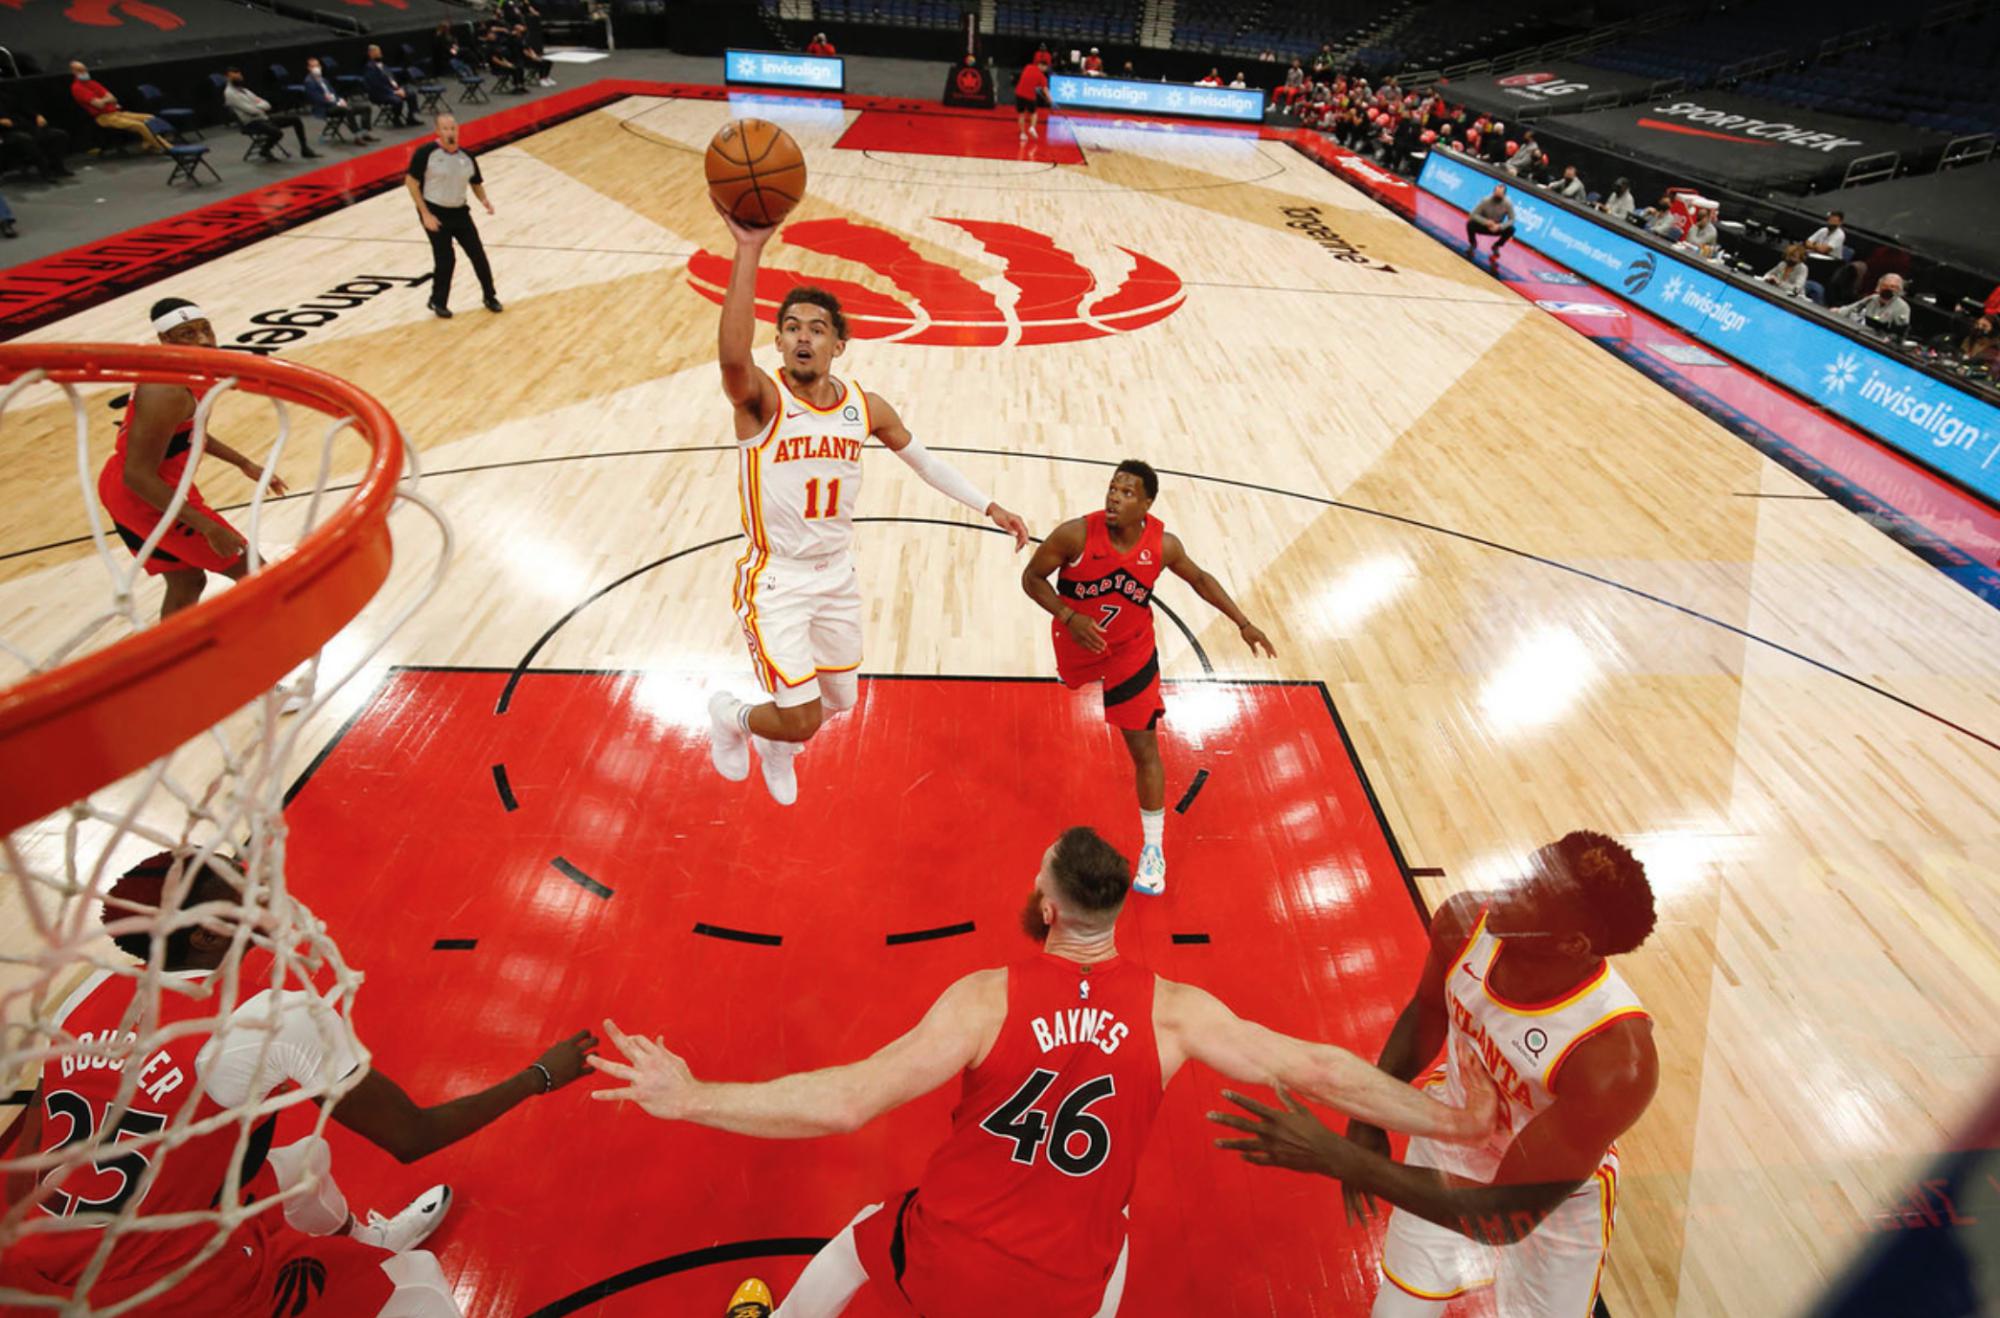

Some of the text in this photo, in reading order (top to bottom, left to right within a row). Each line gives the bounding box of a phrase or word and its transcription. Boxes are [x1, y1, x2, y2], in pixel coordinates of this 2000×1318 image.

[762, 59, 832, 80] invisalign
[1526, 79, 1590, 96] LG
[1083, 82, 1148, 104] invisalign
[1189, 90, 1254, 112] invisalign
[1653, 102, 1863, 152] SPORTCHEK
[1682, 283, 1748, 332] invisalign
[1859, 369, 1981, 450] invisalign
[773, 435, 864, 464] ATLANT
[804, 477, 842, 520] 11
[1075, 574, 1148, 603] RAPTOR
[1099, 604, 1122, 630] 7
[1031, 1007, 1130, 1055] BAYNES
[1449, 990, 1535, 1112] TLANTA
[979, 1067, 1117, 1177] 46
[37, 1089, 168, 1228] 25
